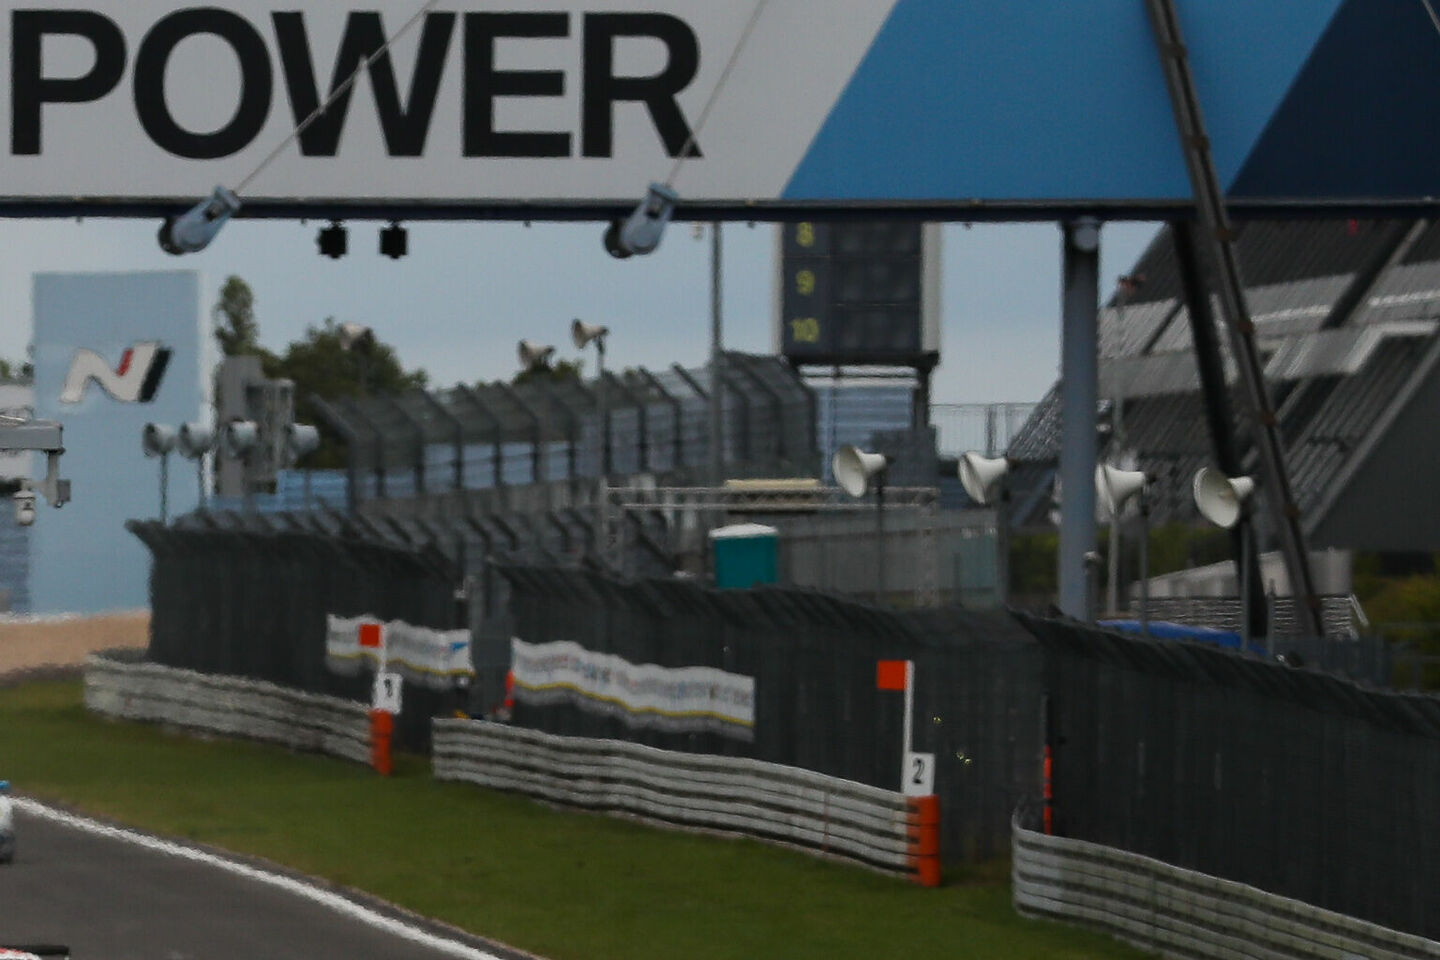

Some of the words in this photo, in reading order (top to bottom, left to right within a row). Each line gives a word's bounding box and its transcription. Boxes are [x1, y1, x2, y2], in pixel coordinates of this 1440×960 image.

[10, 6, 703, 160] POWER
[790, 317, 820, 343] 10
[912, 757, 926, 785] 2
